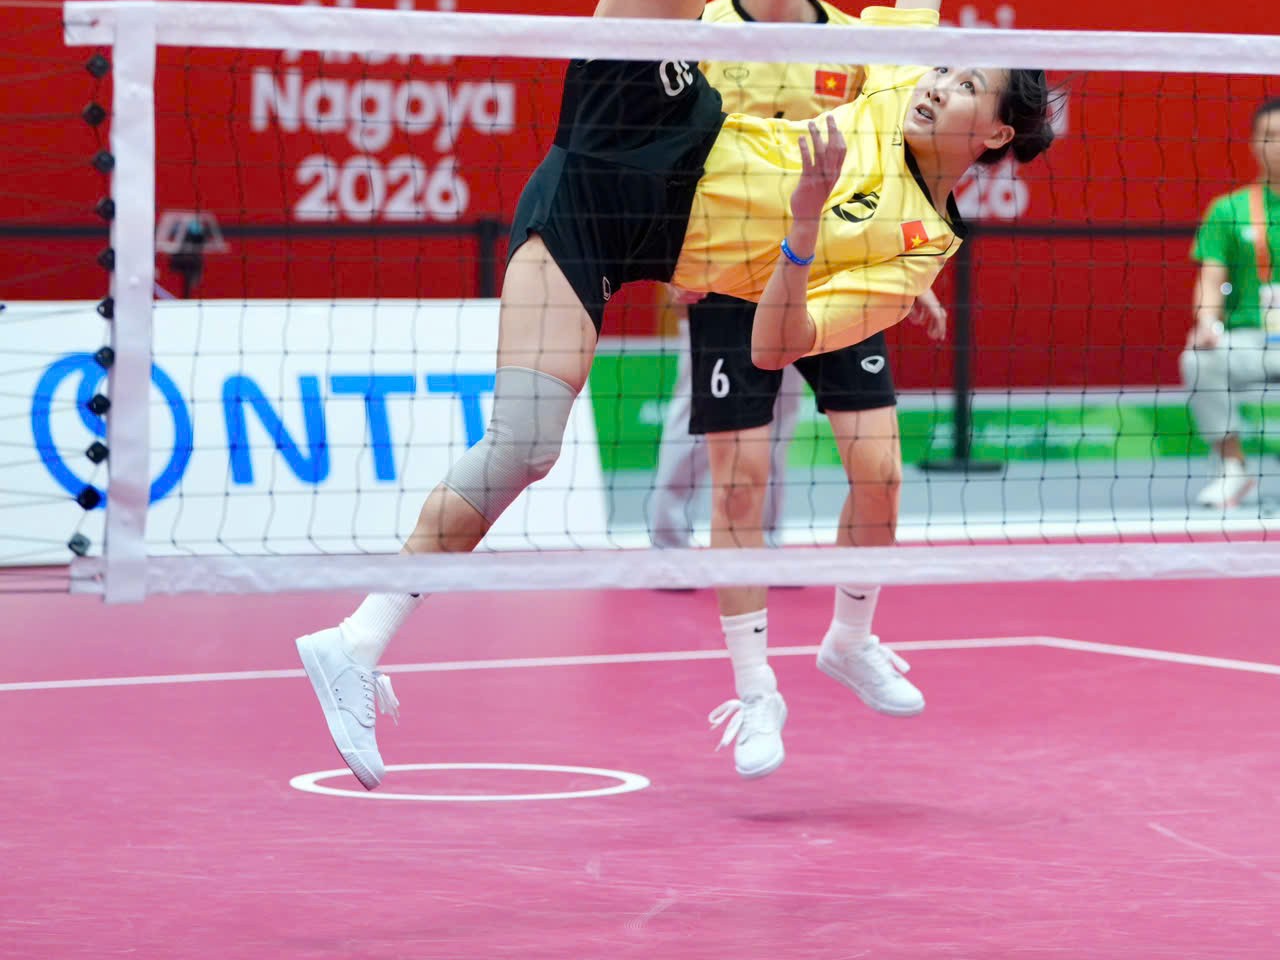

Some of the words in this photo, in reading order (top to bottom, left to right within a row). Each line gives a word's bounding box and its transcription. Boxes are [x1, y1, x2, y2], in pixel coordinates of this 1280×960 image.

[252, 66, 516, 152] Nagoya
[295, 154, 469, 221] 2026
[710, 358, 730, 398] 6
[221, 373, 497, 485] NTT
